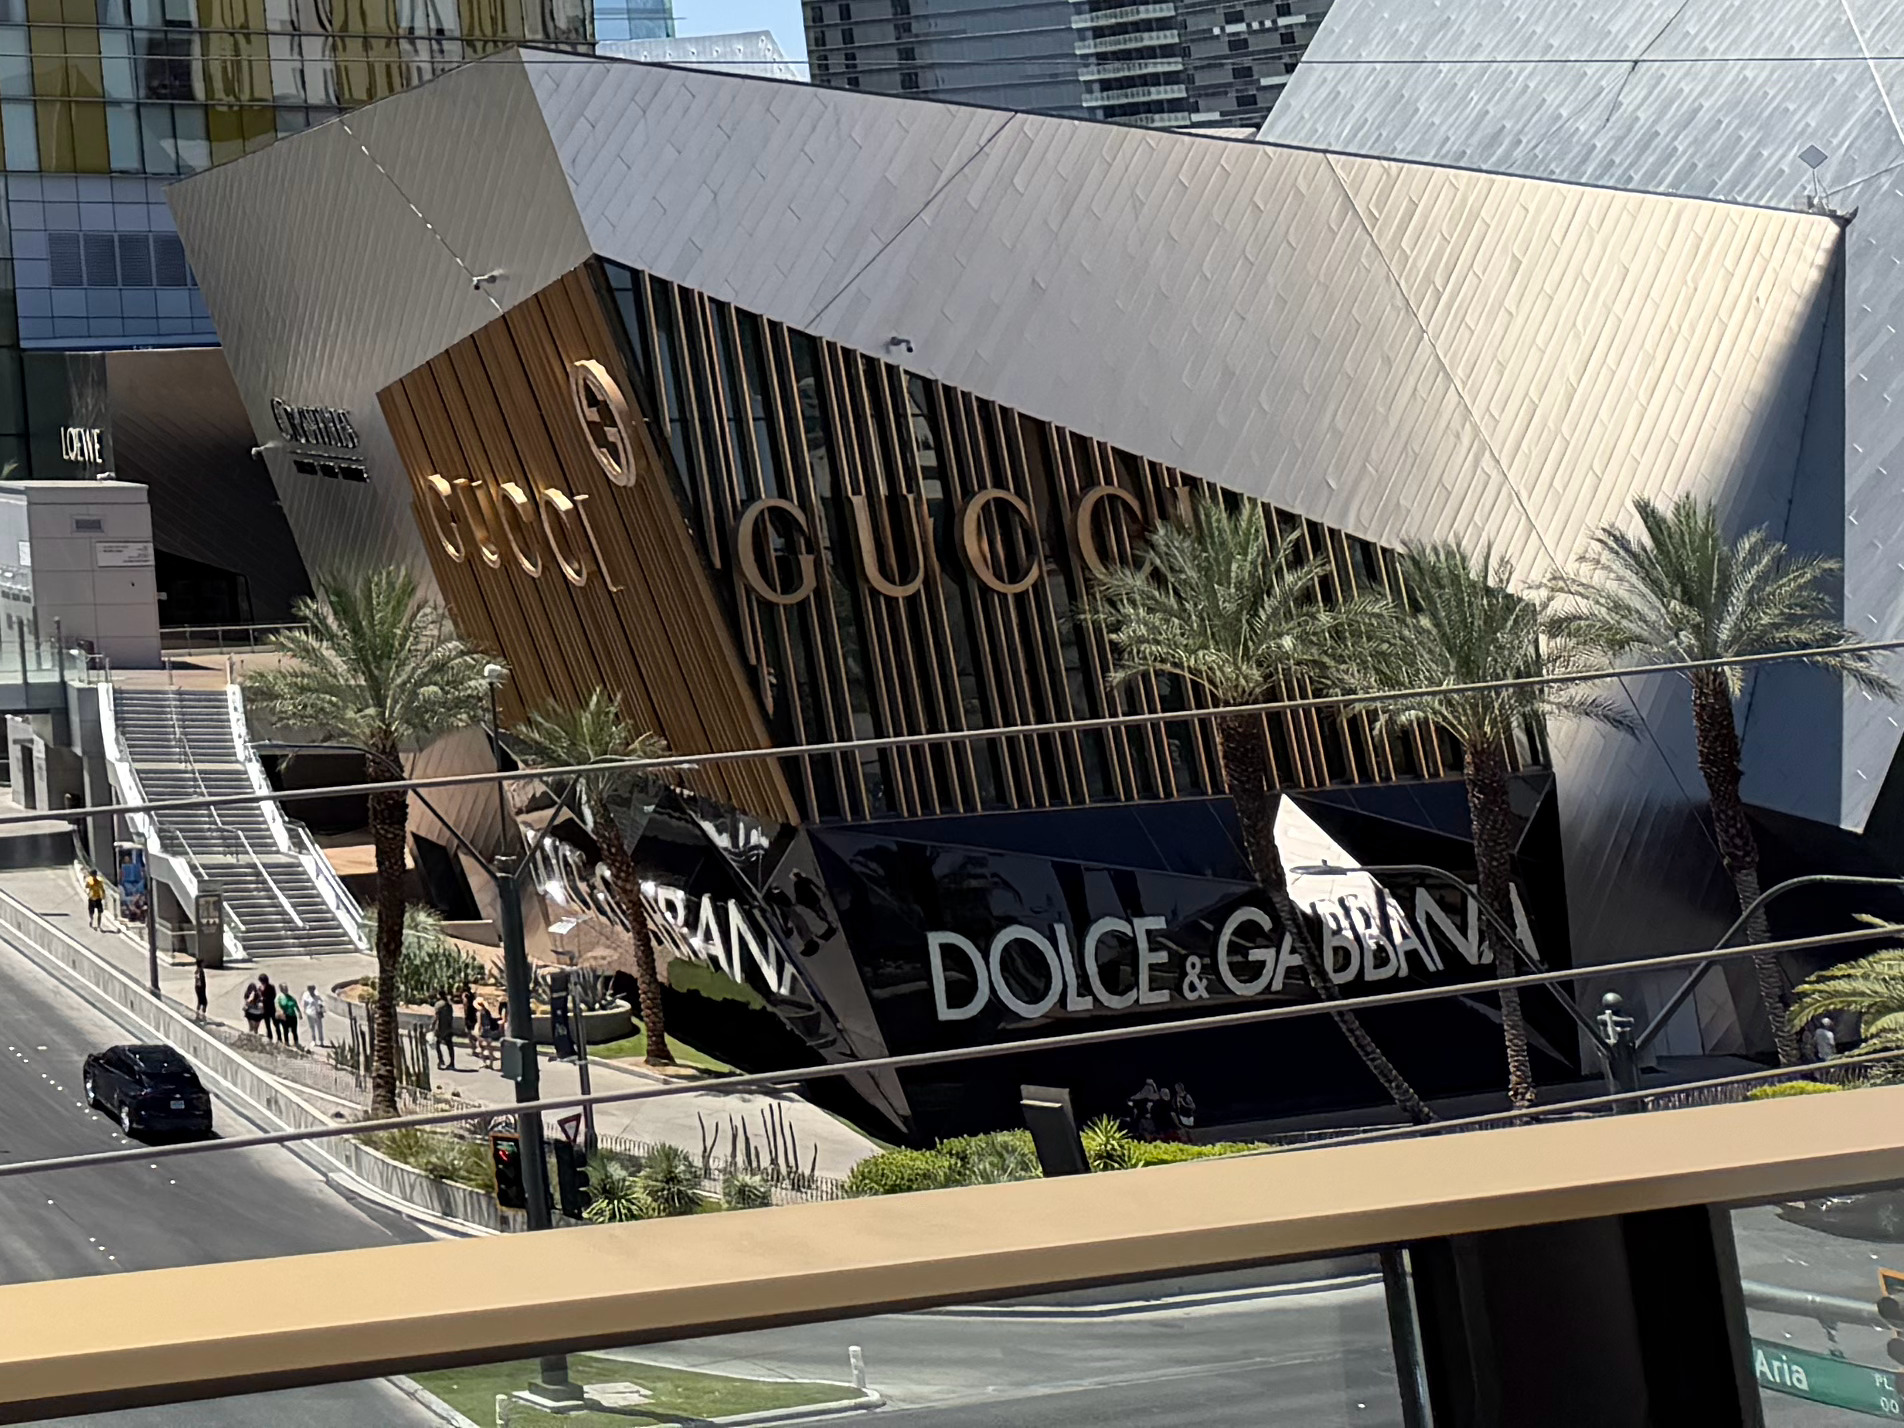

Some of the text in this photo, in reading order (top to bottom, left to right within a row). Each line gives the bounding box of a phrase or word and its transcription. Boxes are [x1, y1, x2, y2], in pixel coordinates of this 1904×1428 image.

[60, 426, 104, 464] LOEWE
[428, 474, 625, 594] GUCCI
[926, 915, 1171, 1021] DOLCE
[1182, 955, 1210, 1000] &
[1754, 1348, 1810, 1392] Aria
